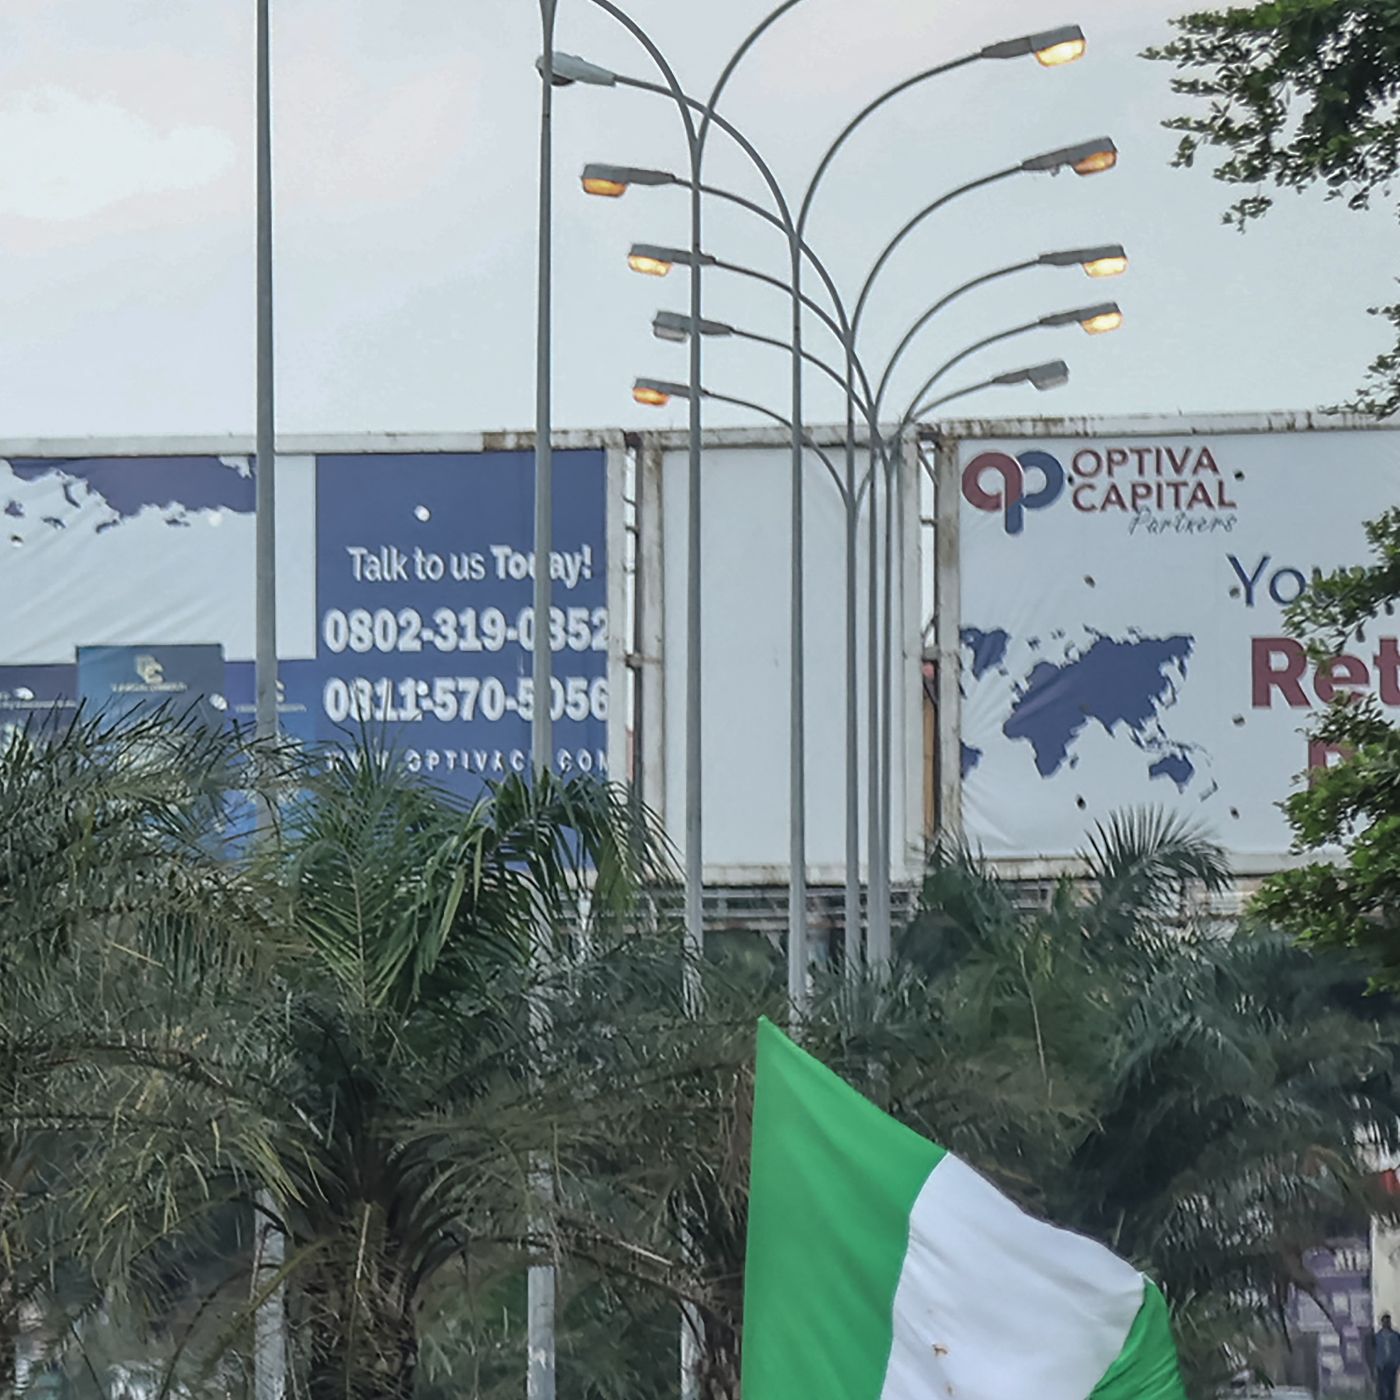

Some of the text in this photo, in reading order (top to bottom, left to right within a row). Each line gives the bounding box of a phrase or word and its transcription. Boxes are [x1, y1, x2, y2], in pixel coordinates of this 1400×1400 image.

[1072, 446, 1220, 478] OPTIVA
[1072, 480, 1237, 513] CAPITAL
[346, 545, 408, 581] Talk
[413, 546, 444, 581] to
[450, 552, 486, 580] us
